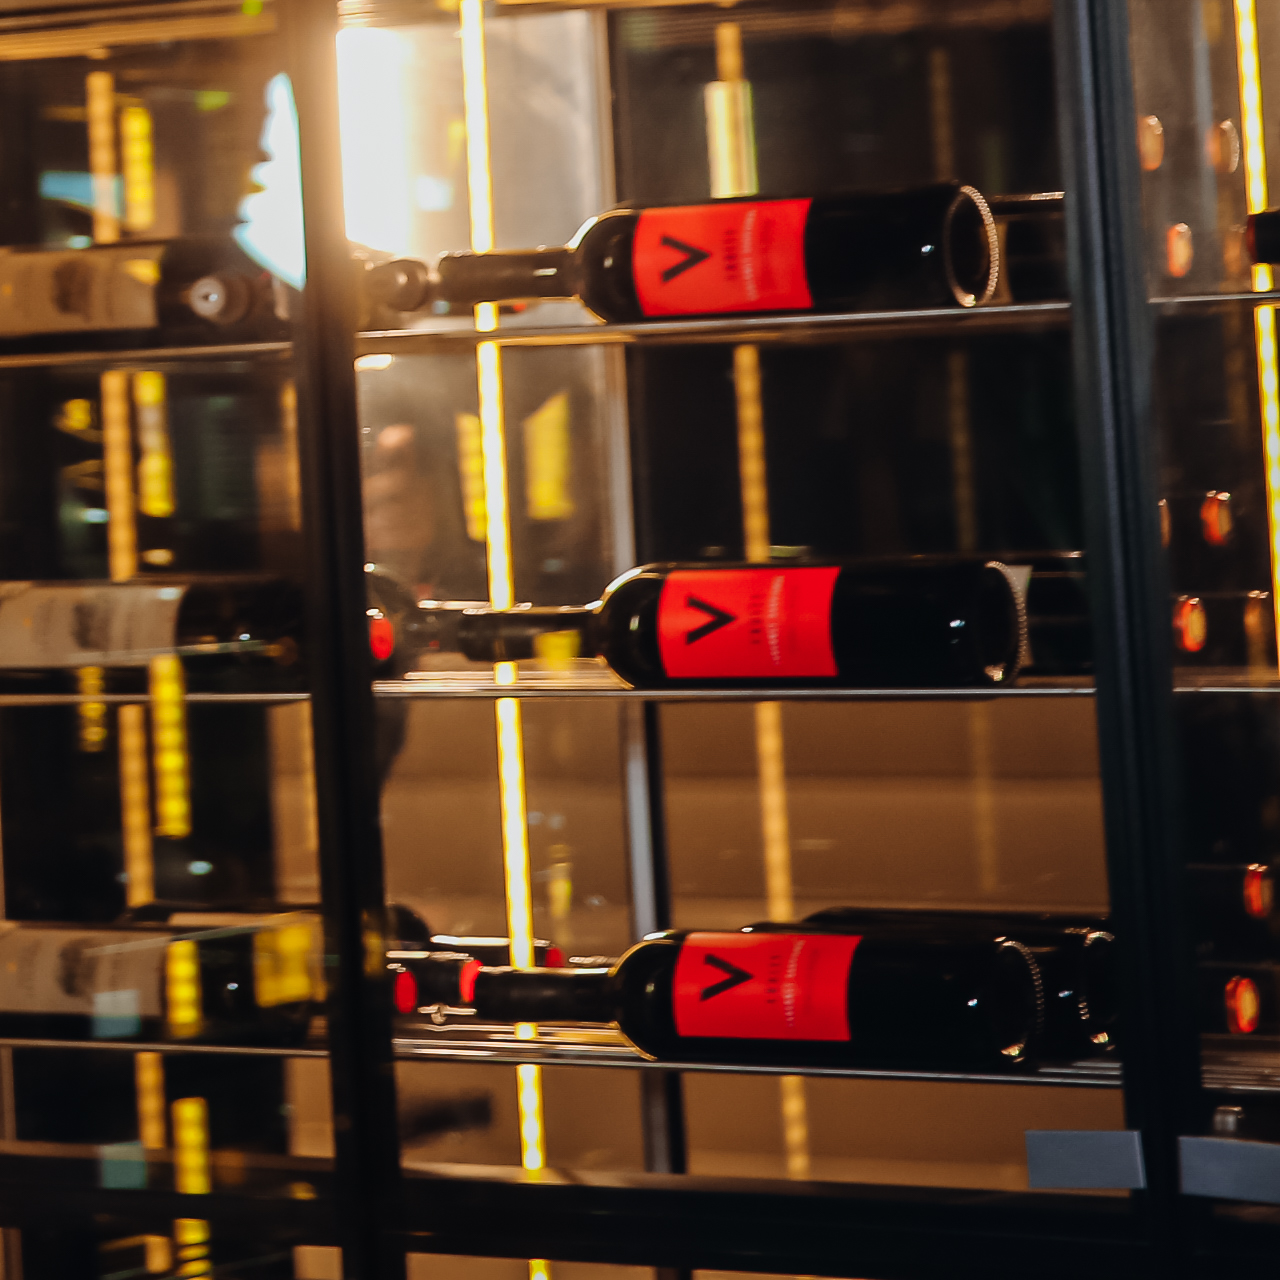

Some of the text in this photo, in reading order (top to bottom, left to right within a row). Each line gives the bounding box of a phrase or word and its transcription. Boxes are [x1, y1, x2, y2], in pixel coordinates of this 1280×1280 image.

[661, 234, 711, 283] V
[686, 595, 737, 645] V
[700, 953, 754, 1002] V
